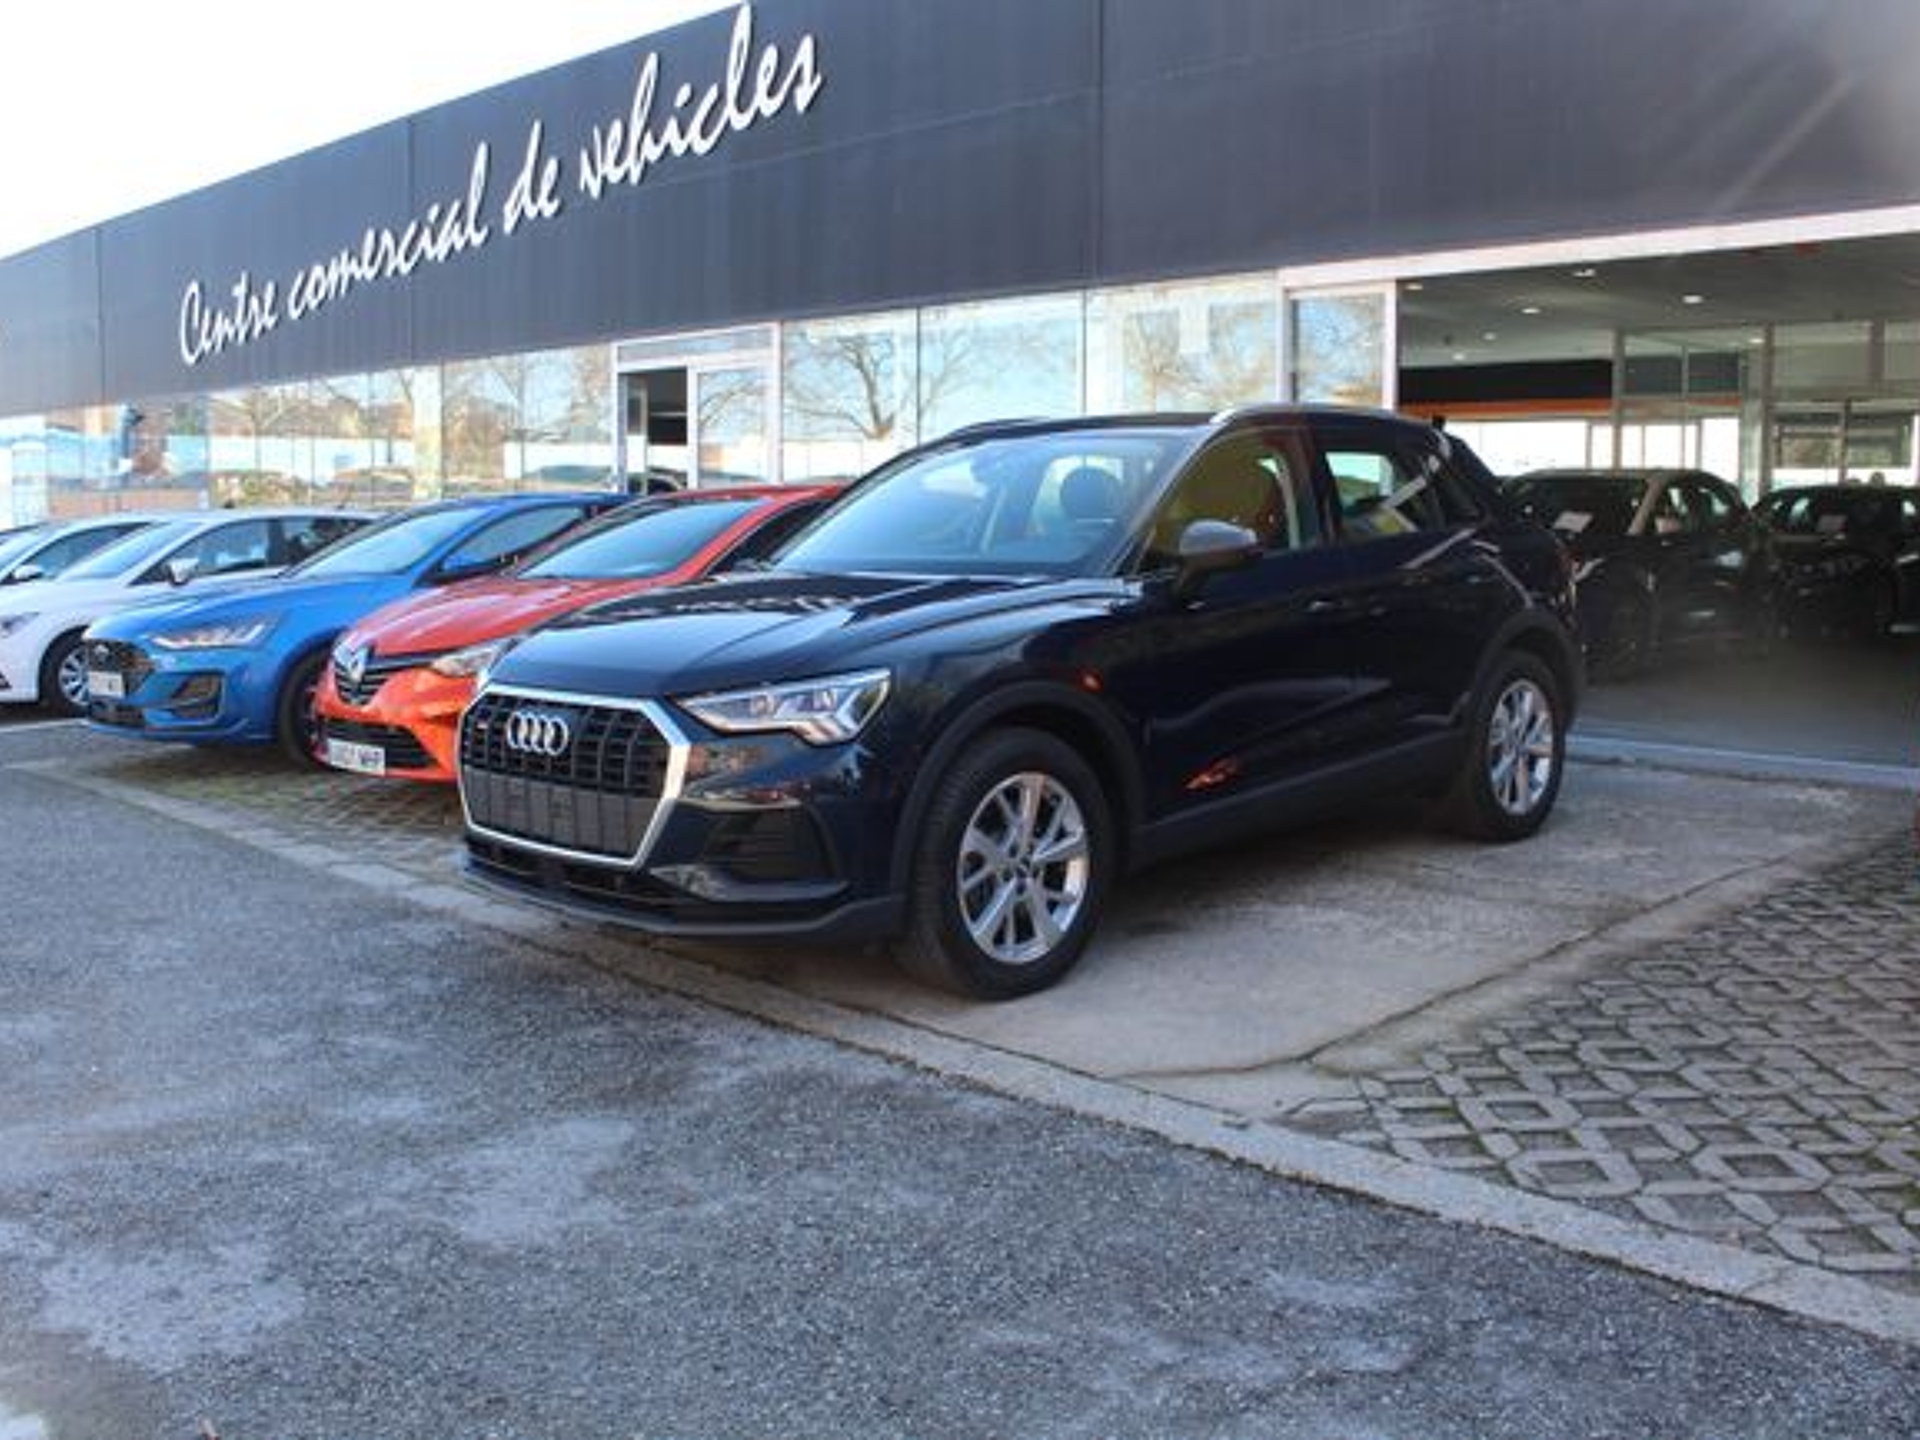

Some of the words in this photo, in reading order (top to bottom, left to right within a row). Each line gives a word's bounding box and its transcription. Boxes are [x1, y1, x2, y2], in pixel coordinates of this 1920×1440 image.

[179, 272, 278, 366] Centre
[287, 141, 491, 320] comercial
[502, 119, 562, 236] de
[579, 3, 824, 200] vehicles
